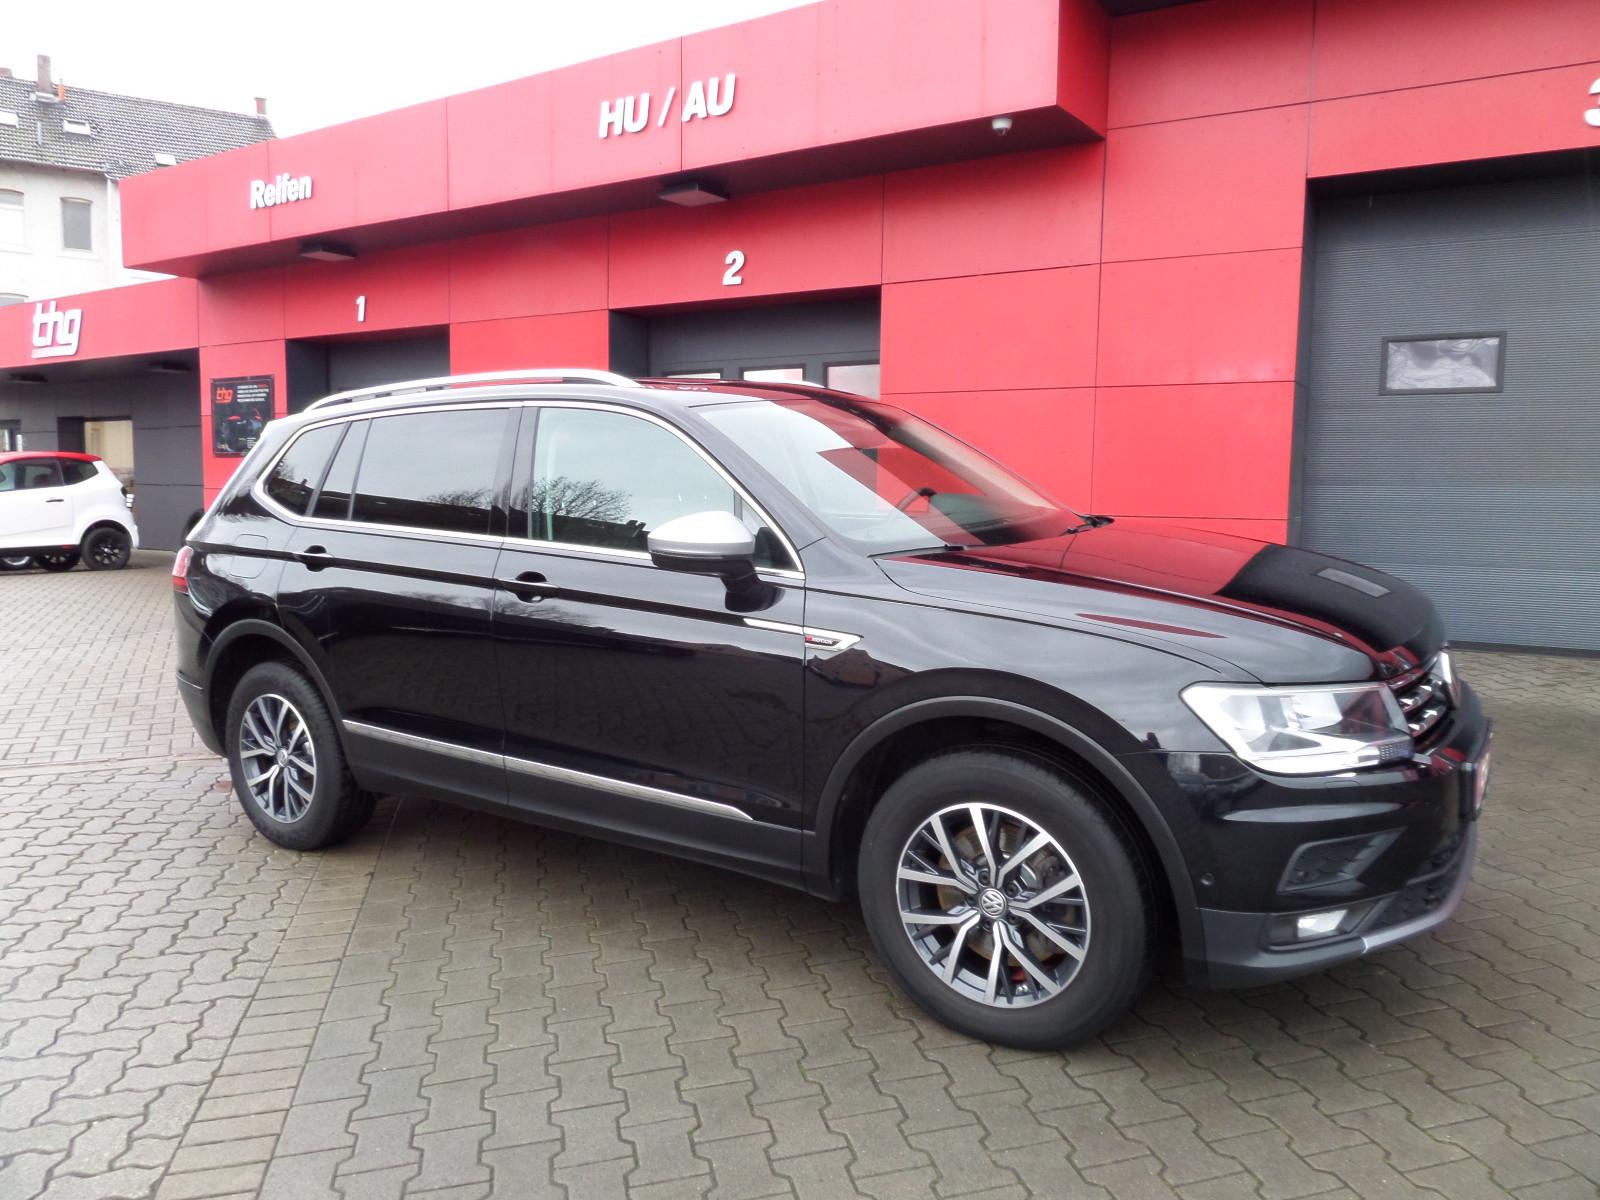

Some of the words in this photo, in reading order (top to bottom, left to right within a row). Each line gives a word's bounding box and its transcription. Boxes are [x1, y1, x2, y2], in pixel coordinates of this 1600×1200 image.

[598, 92, 650, 139] HU
[681, 72, 736, 122] AU
[249, 172, 312, 210] Reifen
[722, 249, 745, 286] 2
[355, 295, 366, 322] 1
[31, 300, 82, 359] thg
